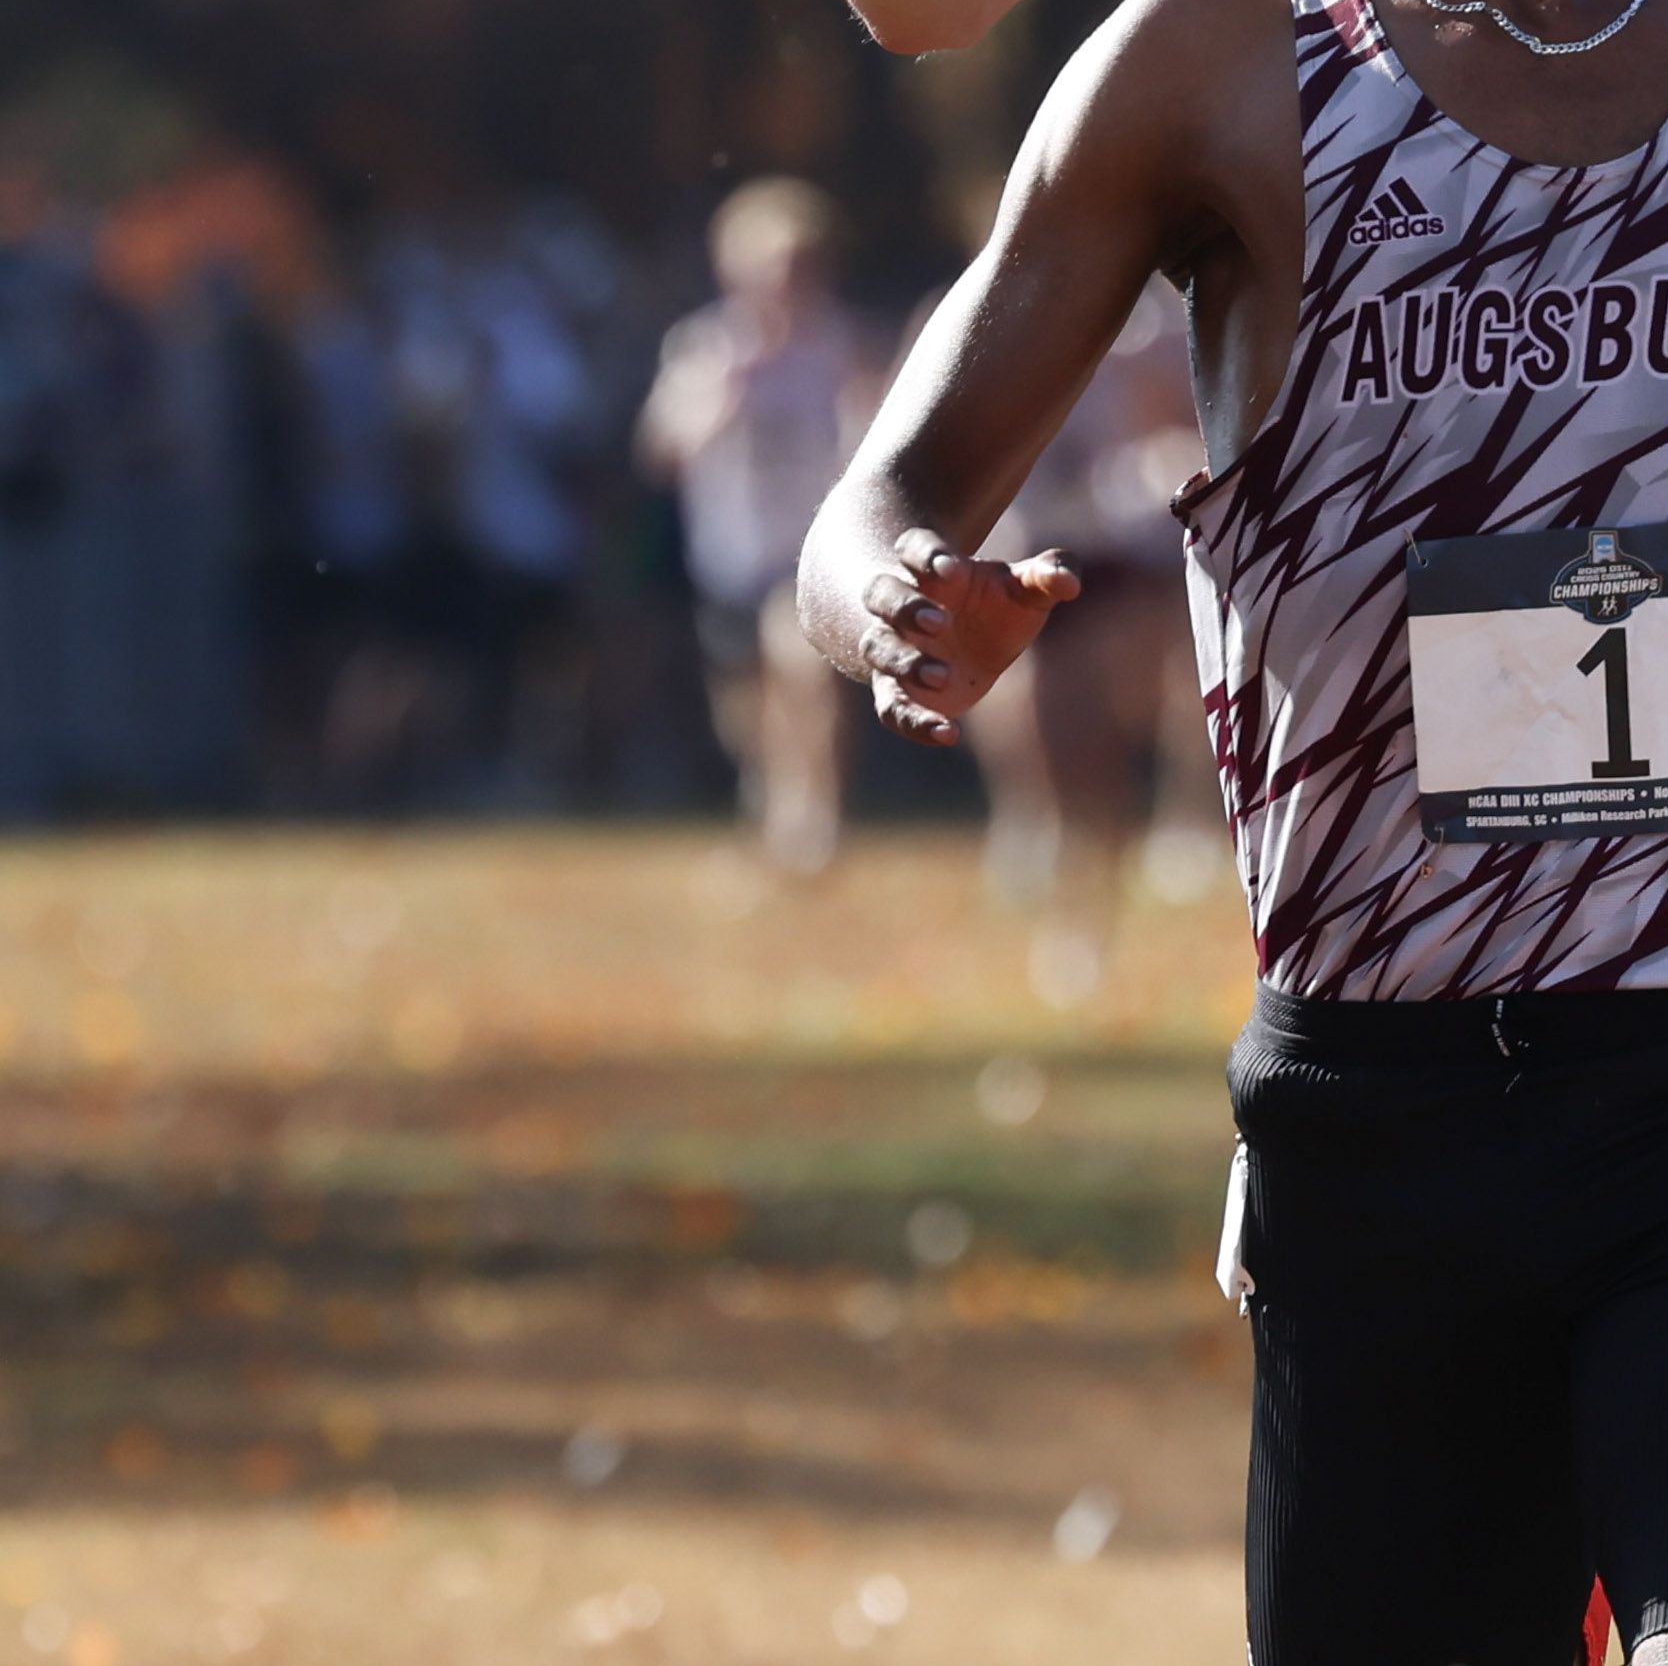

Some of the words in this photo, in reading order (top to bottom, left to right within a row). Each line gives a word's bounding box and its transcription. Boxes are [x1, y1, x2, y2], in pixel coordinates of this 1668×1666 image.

[1350, 215, 1445, 245] adidas
[1554, 580, 1657, 598] CHAMPIONSHIPS
[1576, 627, 1651, 779] 1
[1469, 795, 1497, 808] NCAA
[1501, 794, 1520, 806] DIII
[1524, 792, 1539, 806] XC
[1543, 789, 1635, 806] CHAMPIONSHIPS
[1466, 816, 1531, 827] SPARTANBURG,
[1534, 815, 1547, 825] SC
[1561, 812, 1598, 823] Milliken
[1601, 809, 1646, 821] Research
[1650, 807, 1668, 818] Park
